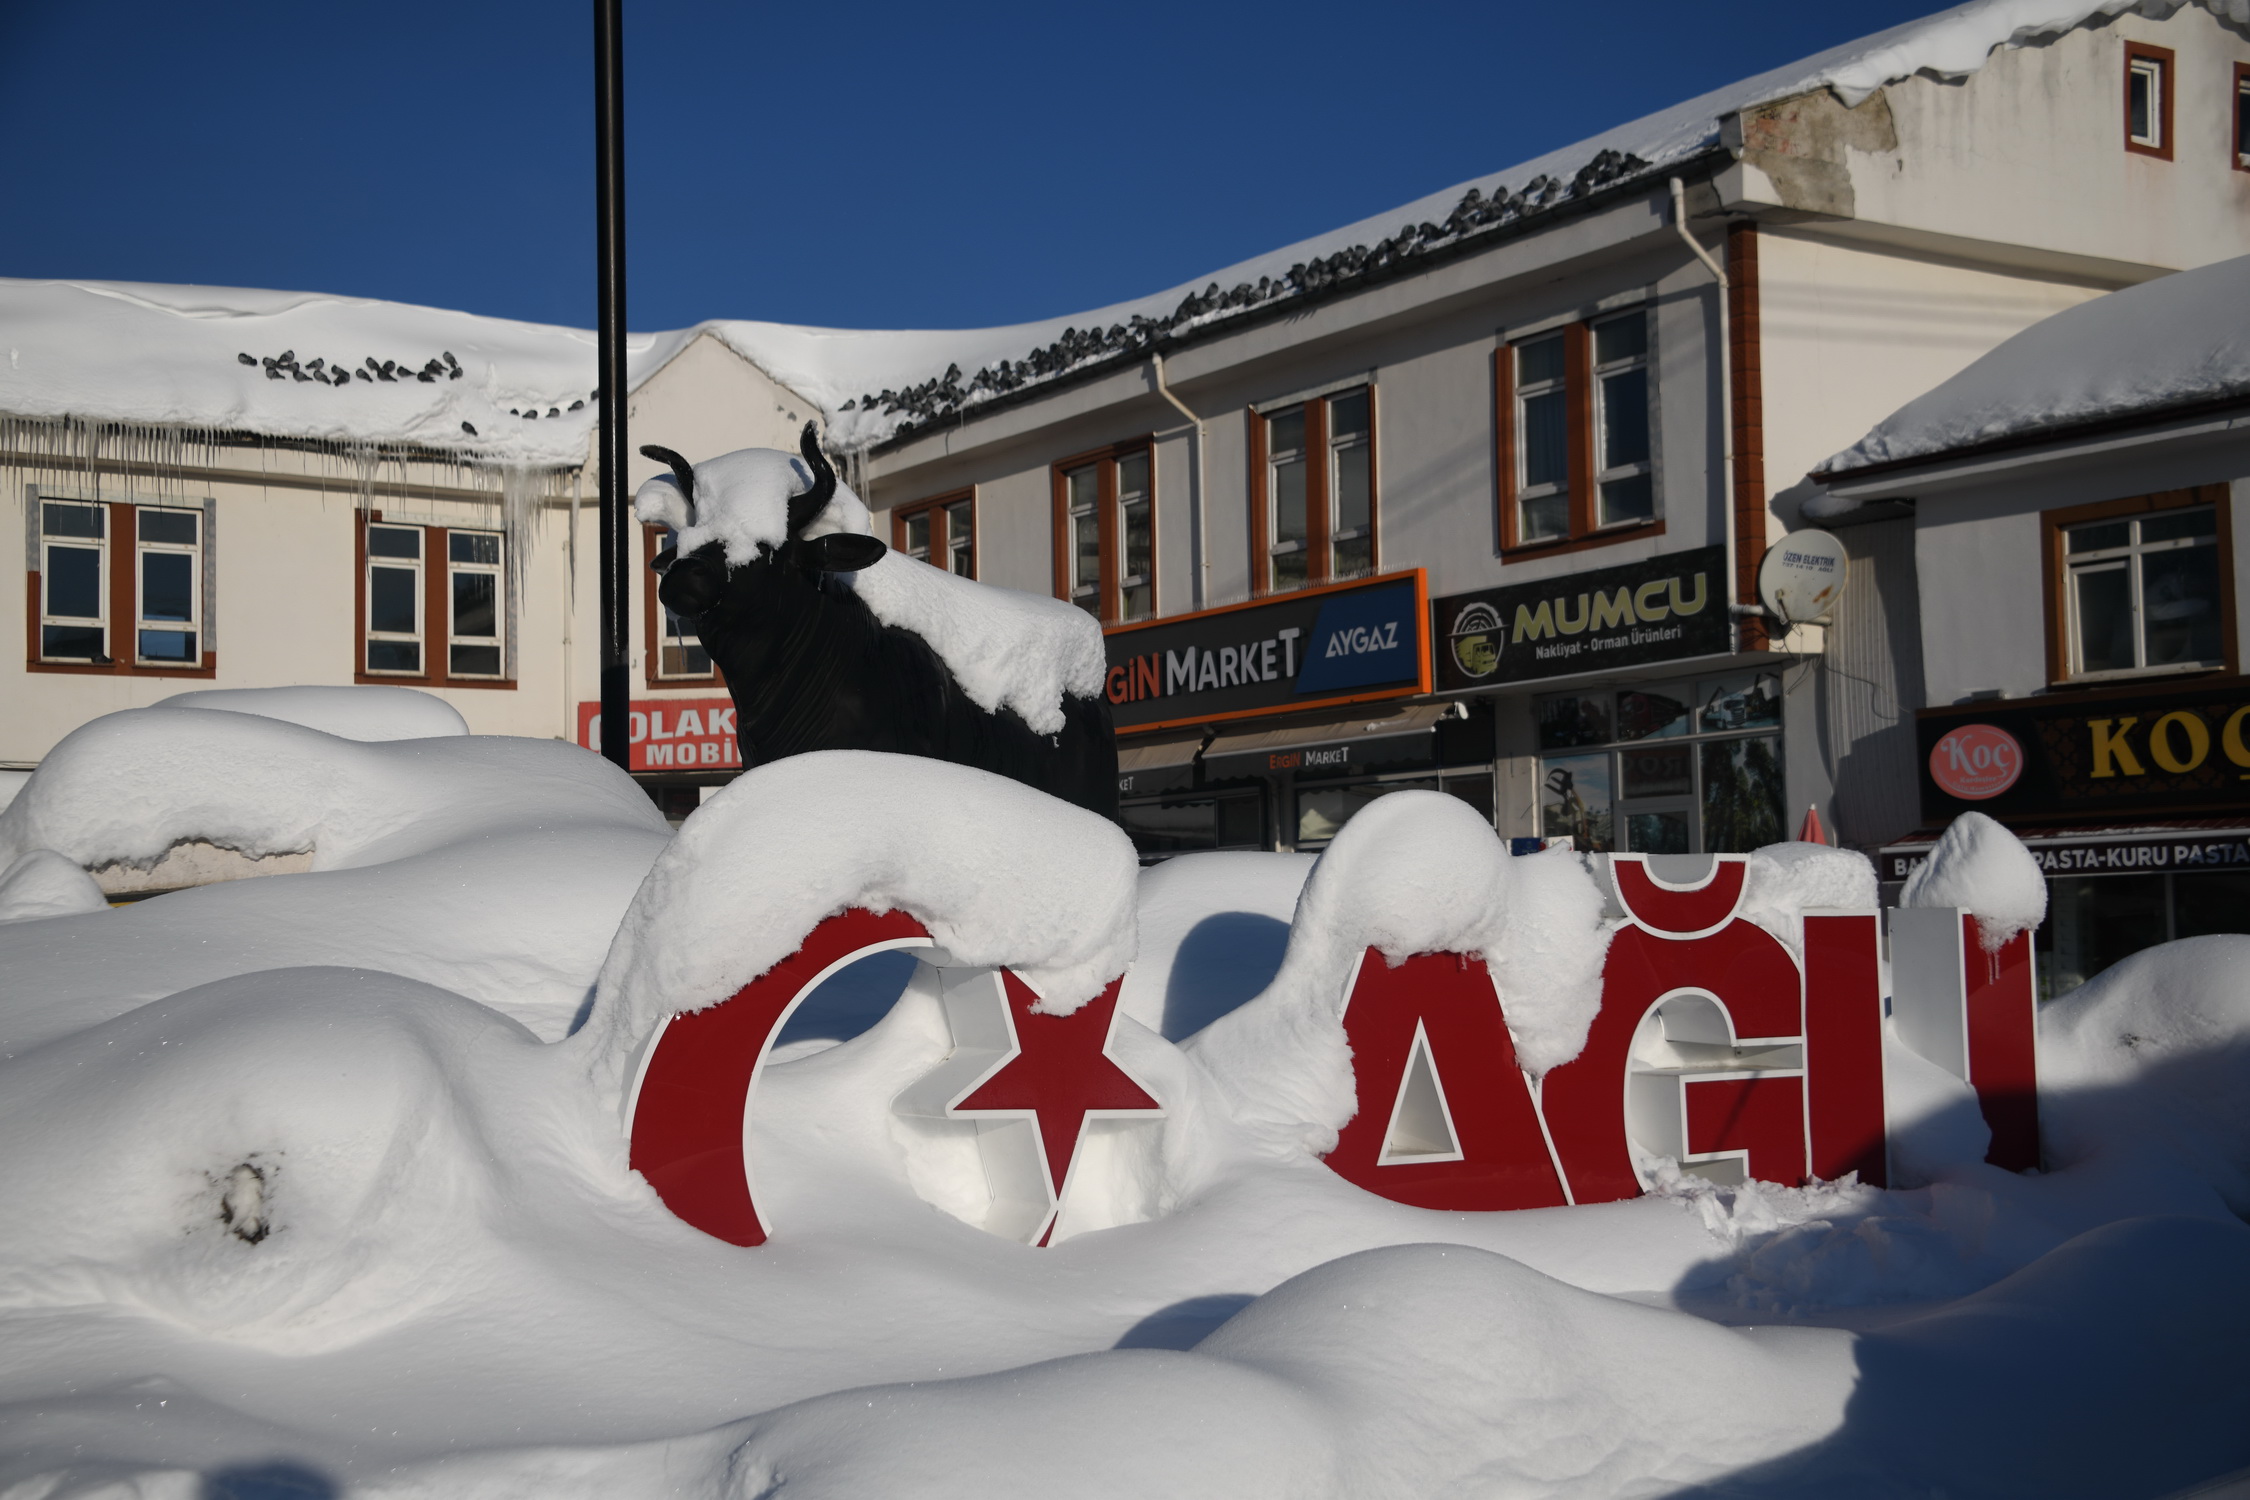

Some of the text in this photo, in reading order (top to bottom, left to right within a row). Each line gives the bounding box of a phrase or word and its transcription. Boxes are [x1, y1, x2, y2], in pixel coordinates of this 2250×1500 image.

[1511, 572, 1707, 644] MUMCU
[1325, 621, 1399, 658] AYGAZ
[1536, 640, 1582, 660] Nakliyat
[1591, 634, 1629, 652] Orman
[1631, 624, 1682, 646] Ürünleri
[646, 738, 743, 767] MOBİ
[1940, 734, 2010, 778] Koç
[2174, 843, 2250, 865] PASTA
